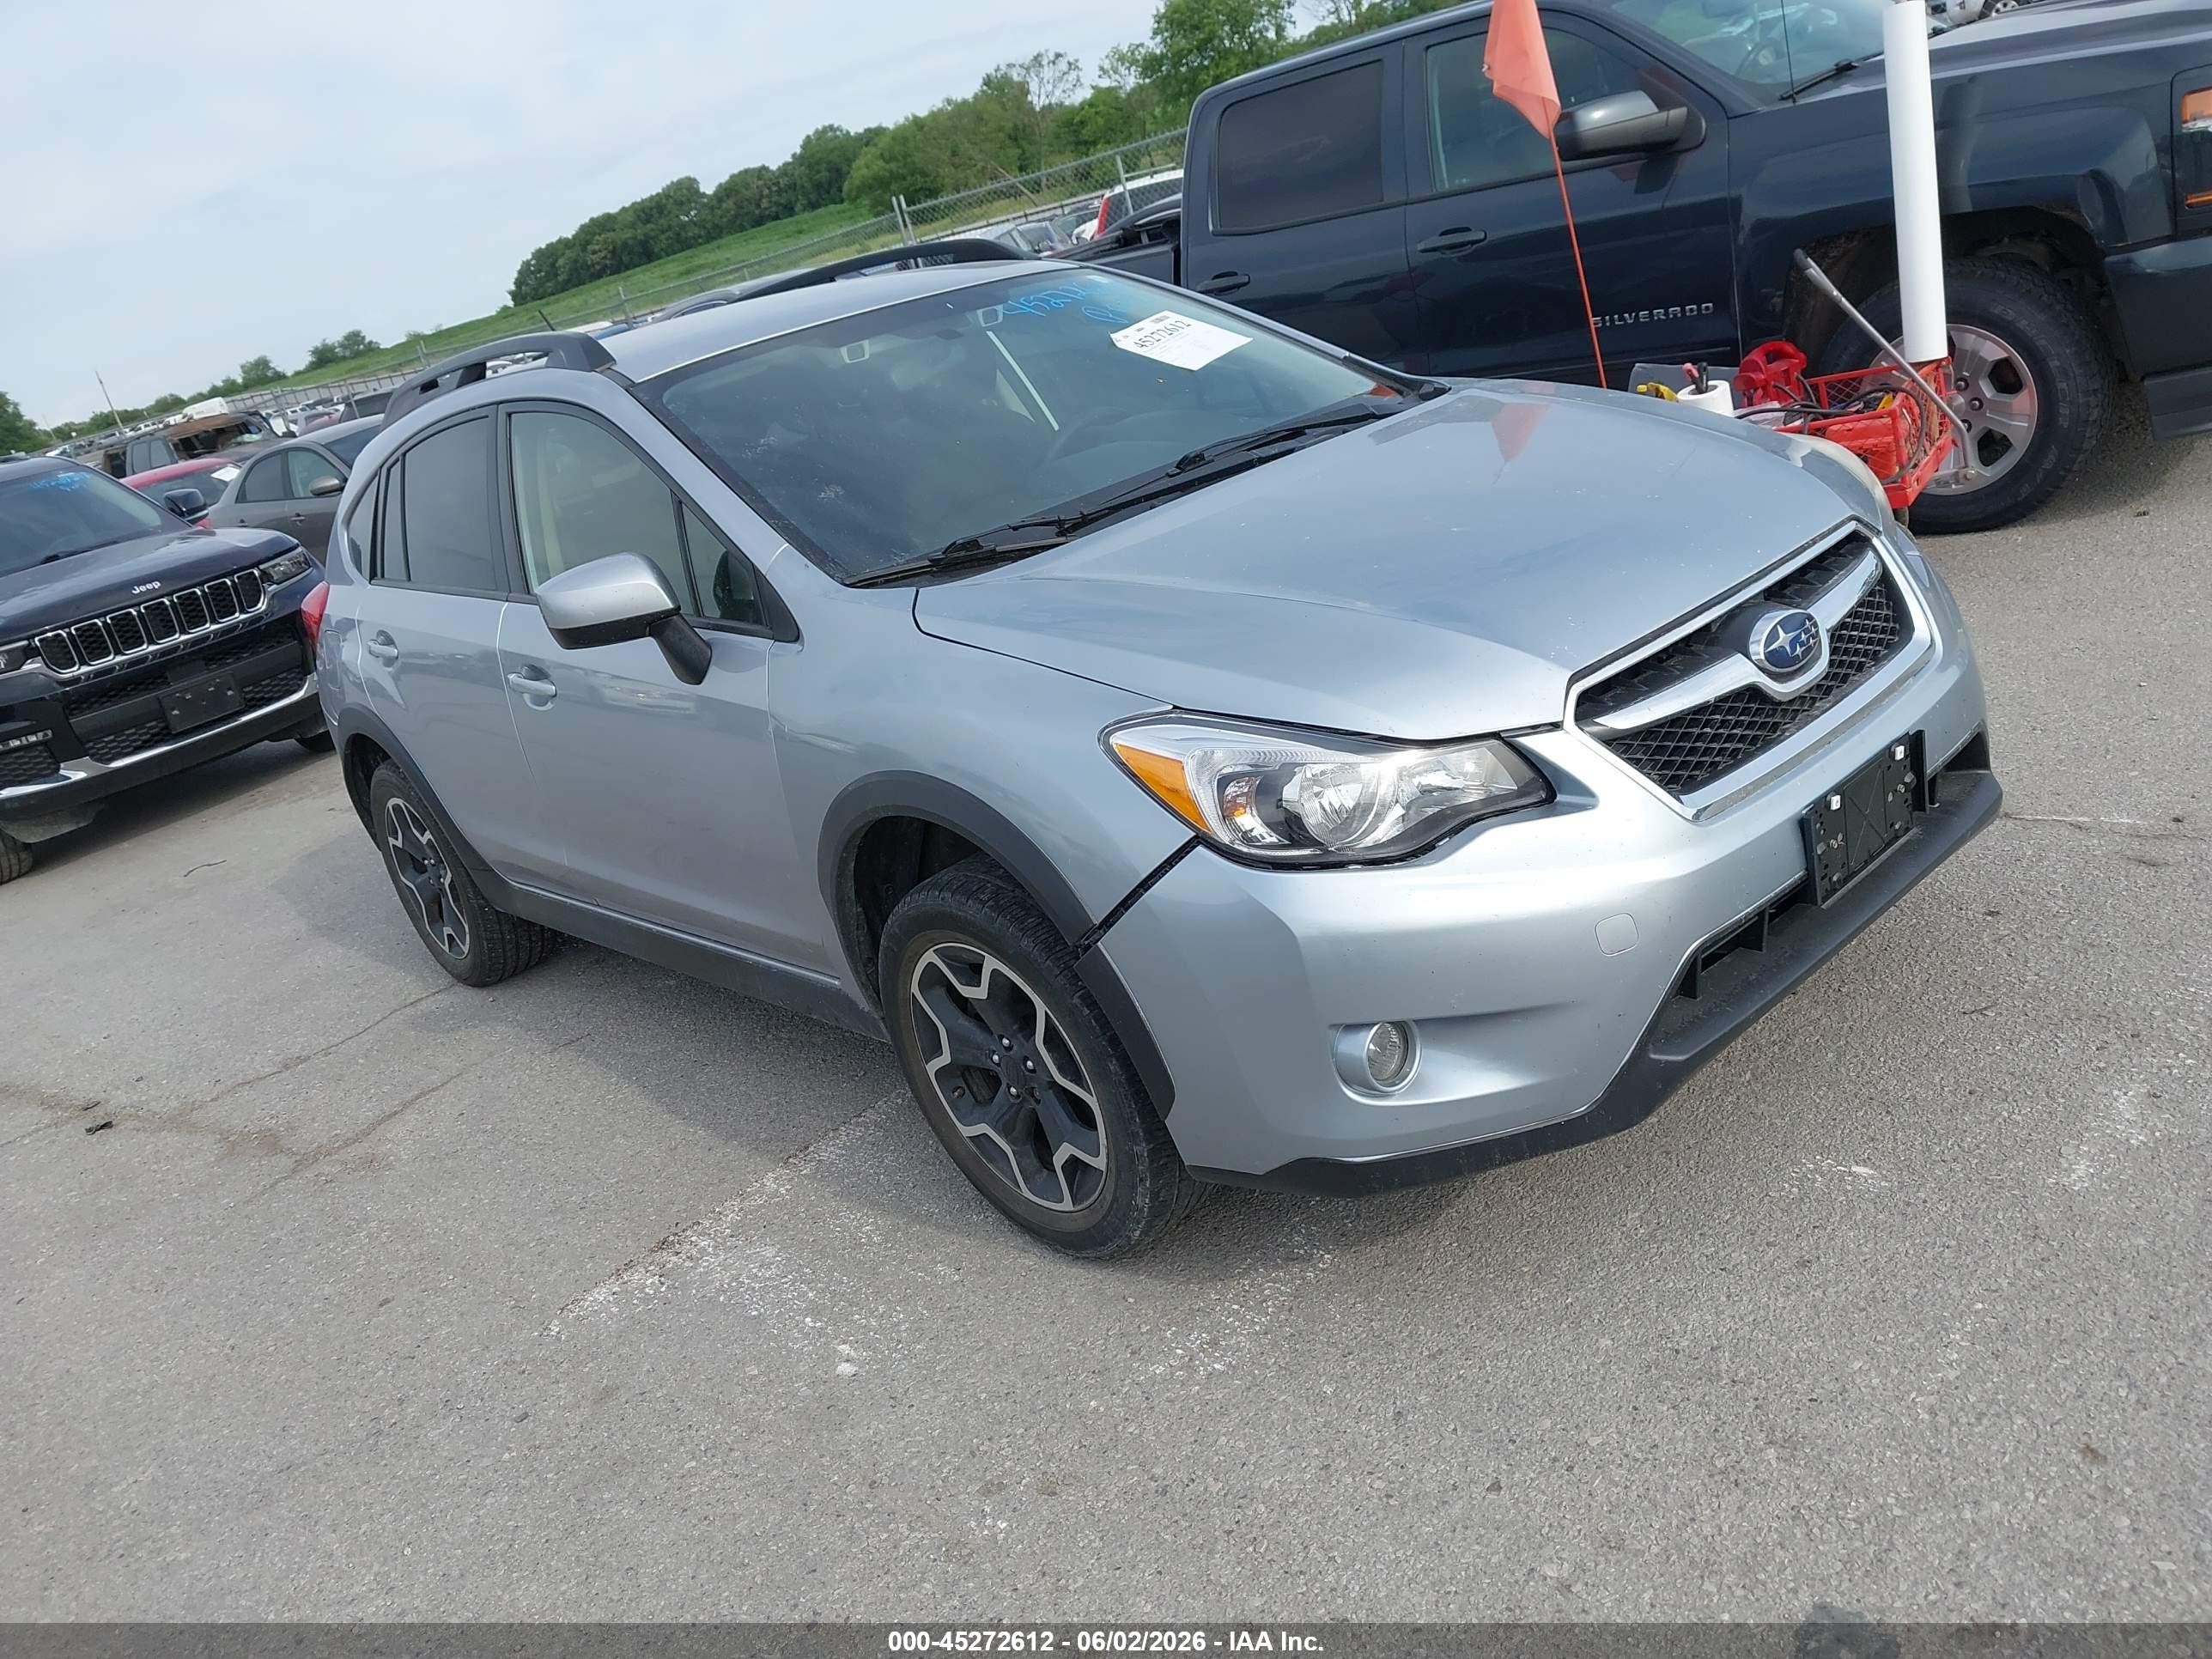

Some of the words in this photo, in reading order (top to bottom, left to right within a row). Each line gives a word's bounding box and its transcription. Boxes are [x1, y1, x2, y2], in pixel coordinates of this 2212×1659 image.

[1590, 302, 1714, 328] SILVERADO
[1133, 320, 1192, 349] 45272612
[131, 580, 161, 594] Jeep
